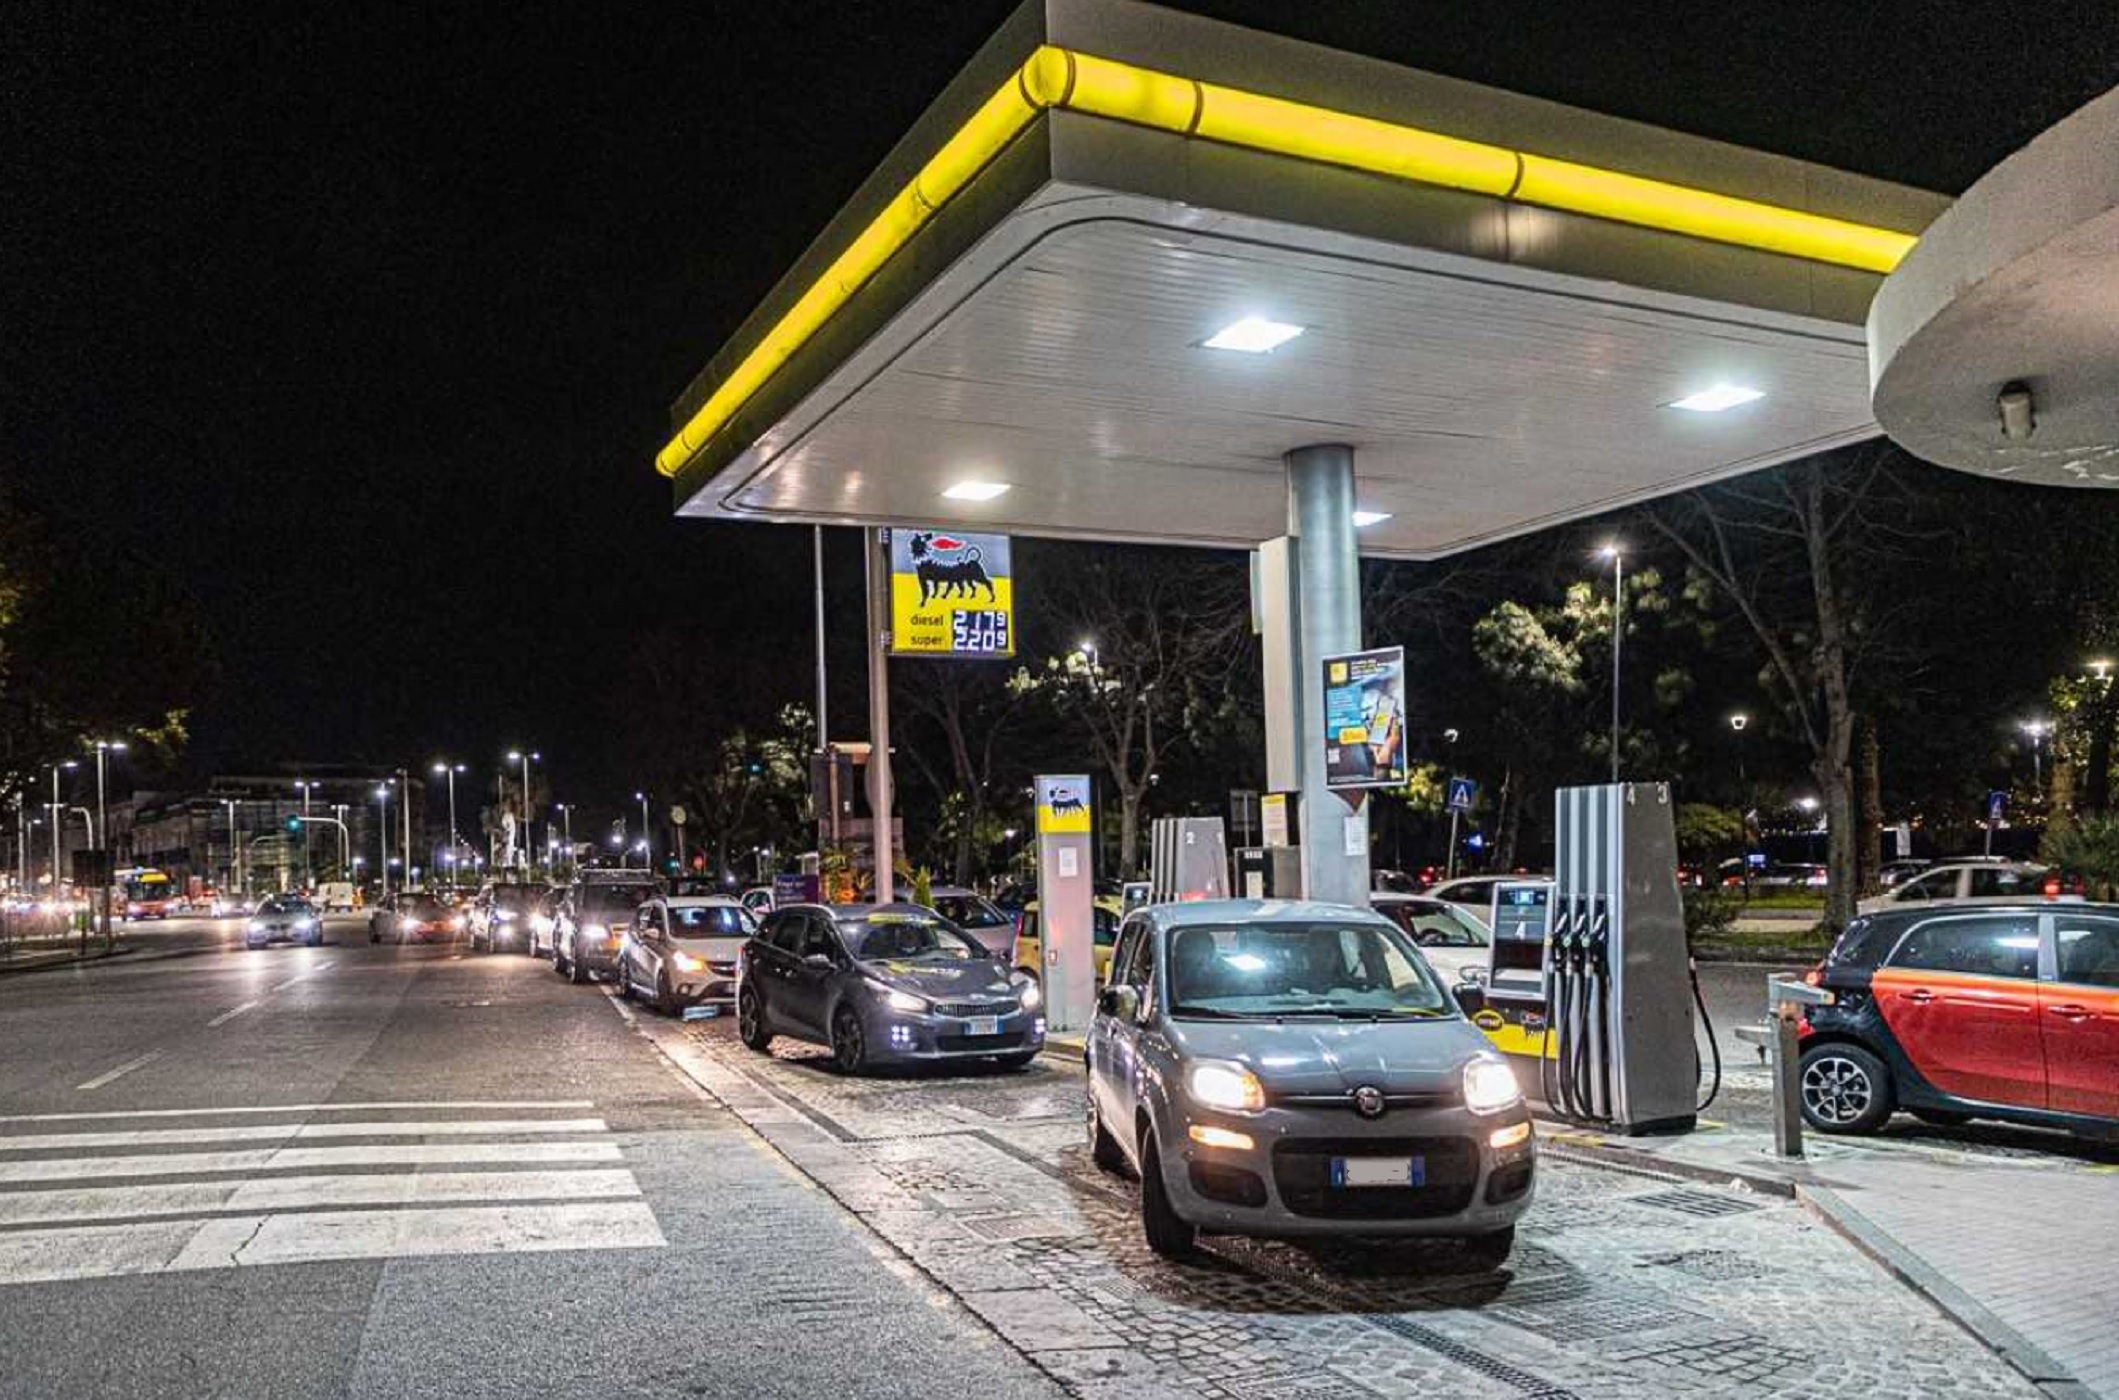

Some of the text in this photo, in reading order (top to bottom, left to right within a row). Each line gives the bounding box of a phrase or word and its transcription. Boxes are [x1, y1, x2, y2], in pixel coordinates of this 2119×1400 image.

[910, 614, 944, 626] diesel
[910, 636, 942, 646] super
[1626, 785, 1668, 806] 4 3
[1186, 831, 1223, 844] 2 1
